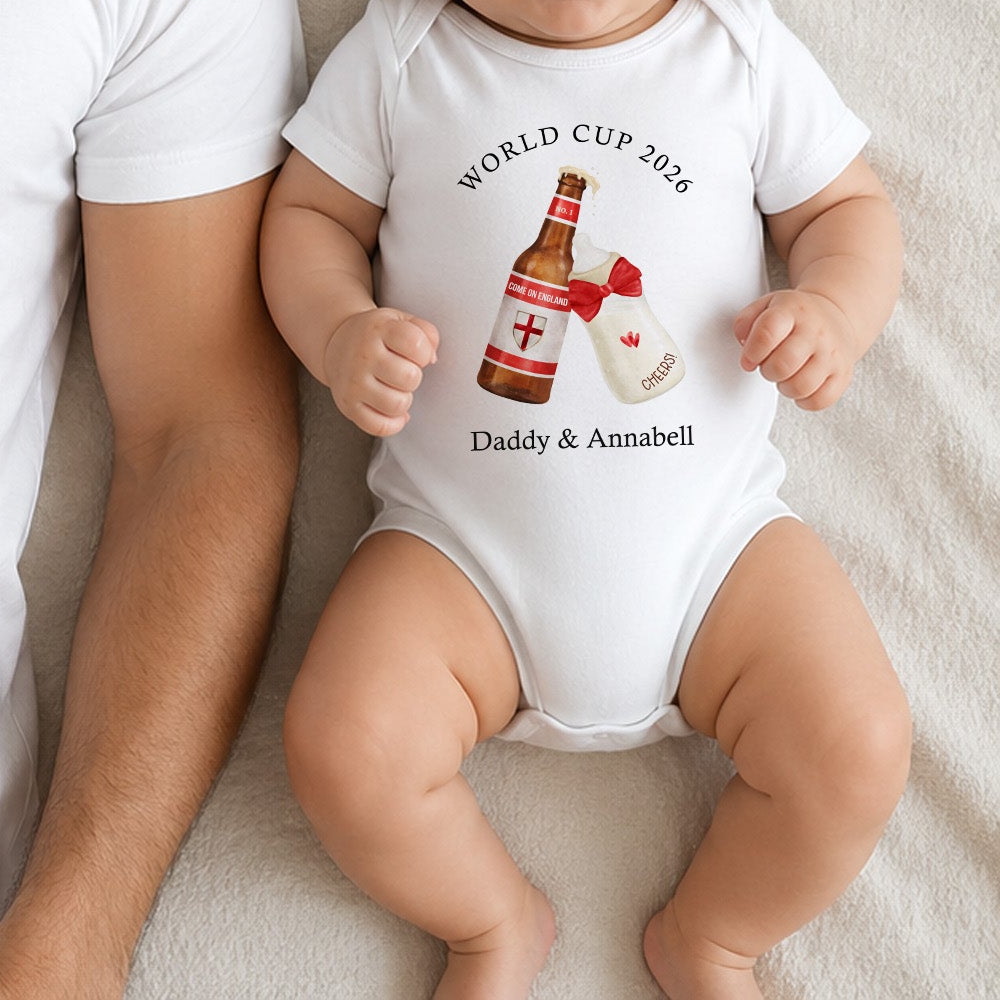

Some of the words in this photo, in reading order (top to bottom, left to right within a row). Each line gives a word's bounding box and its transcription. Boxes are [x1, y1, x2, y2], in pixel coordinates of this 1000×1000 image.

[457, 126, 559, 192] WORLD
[572, 124, 633, 151] CUP
[639, 144, 693, 194] 2026
[555, 206, 568, 215] NO.
[508, 282, 528, 295] COME
[527, 288, 538, 299] ON
[538, 292, 568, 306] ENGLAND
[641, 352, 678, 391] CHEERS!
[471, 429, 550, 455] Daddy
[557, 428, 579, 450] &
[587, 425, 694, 449] Annabell
